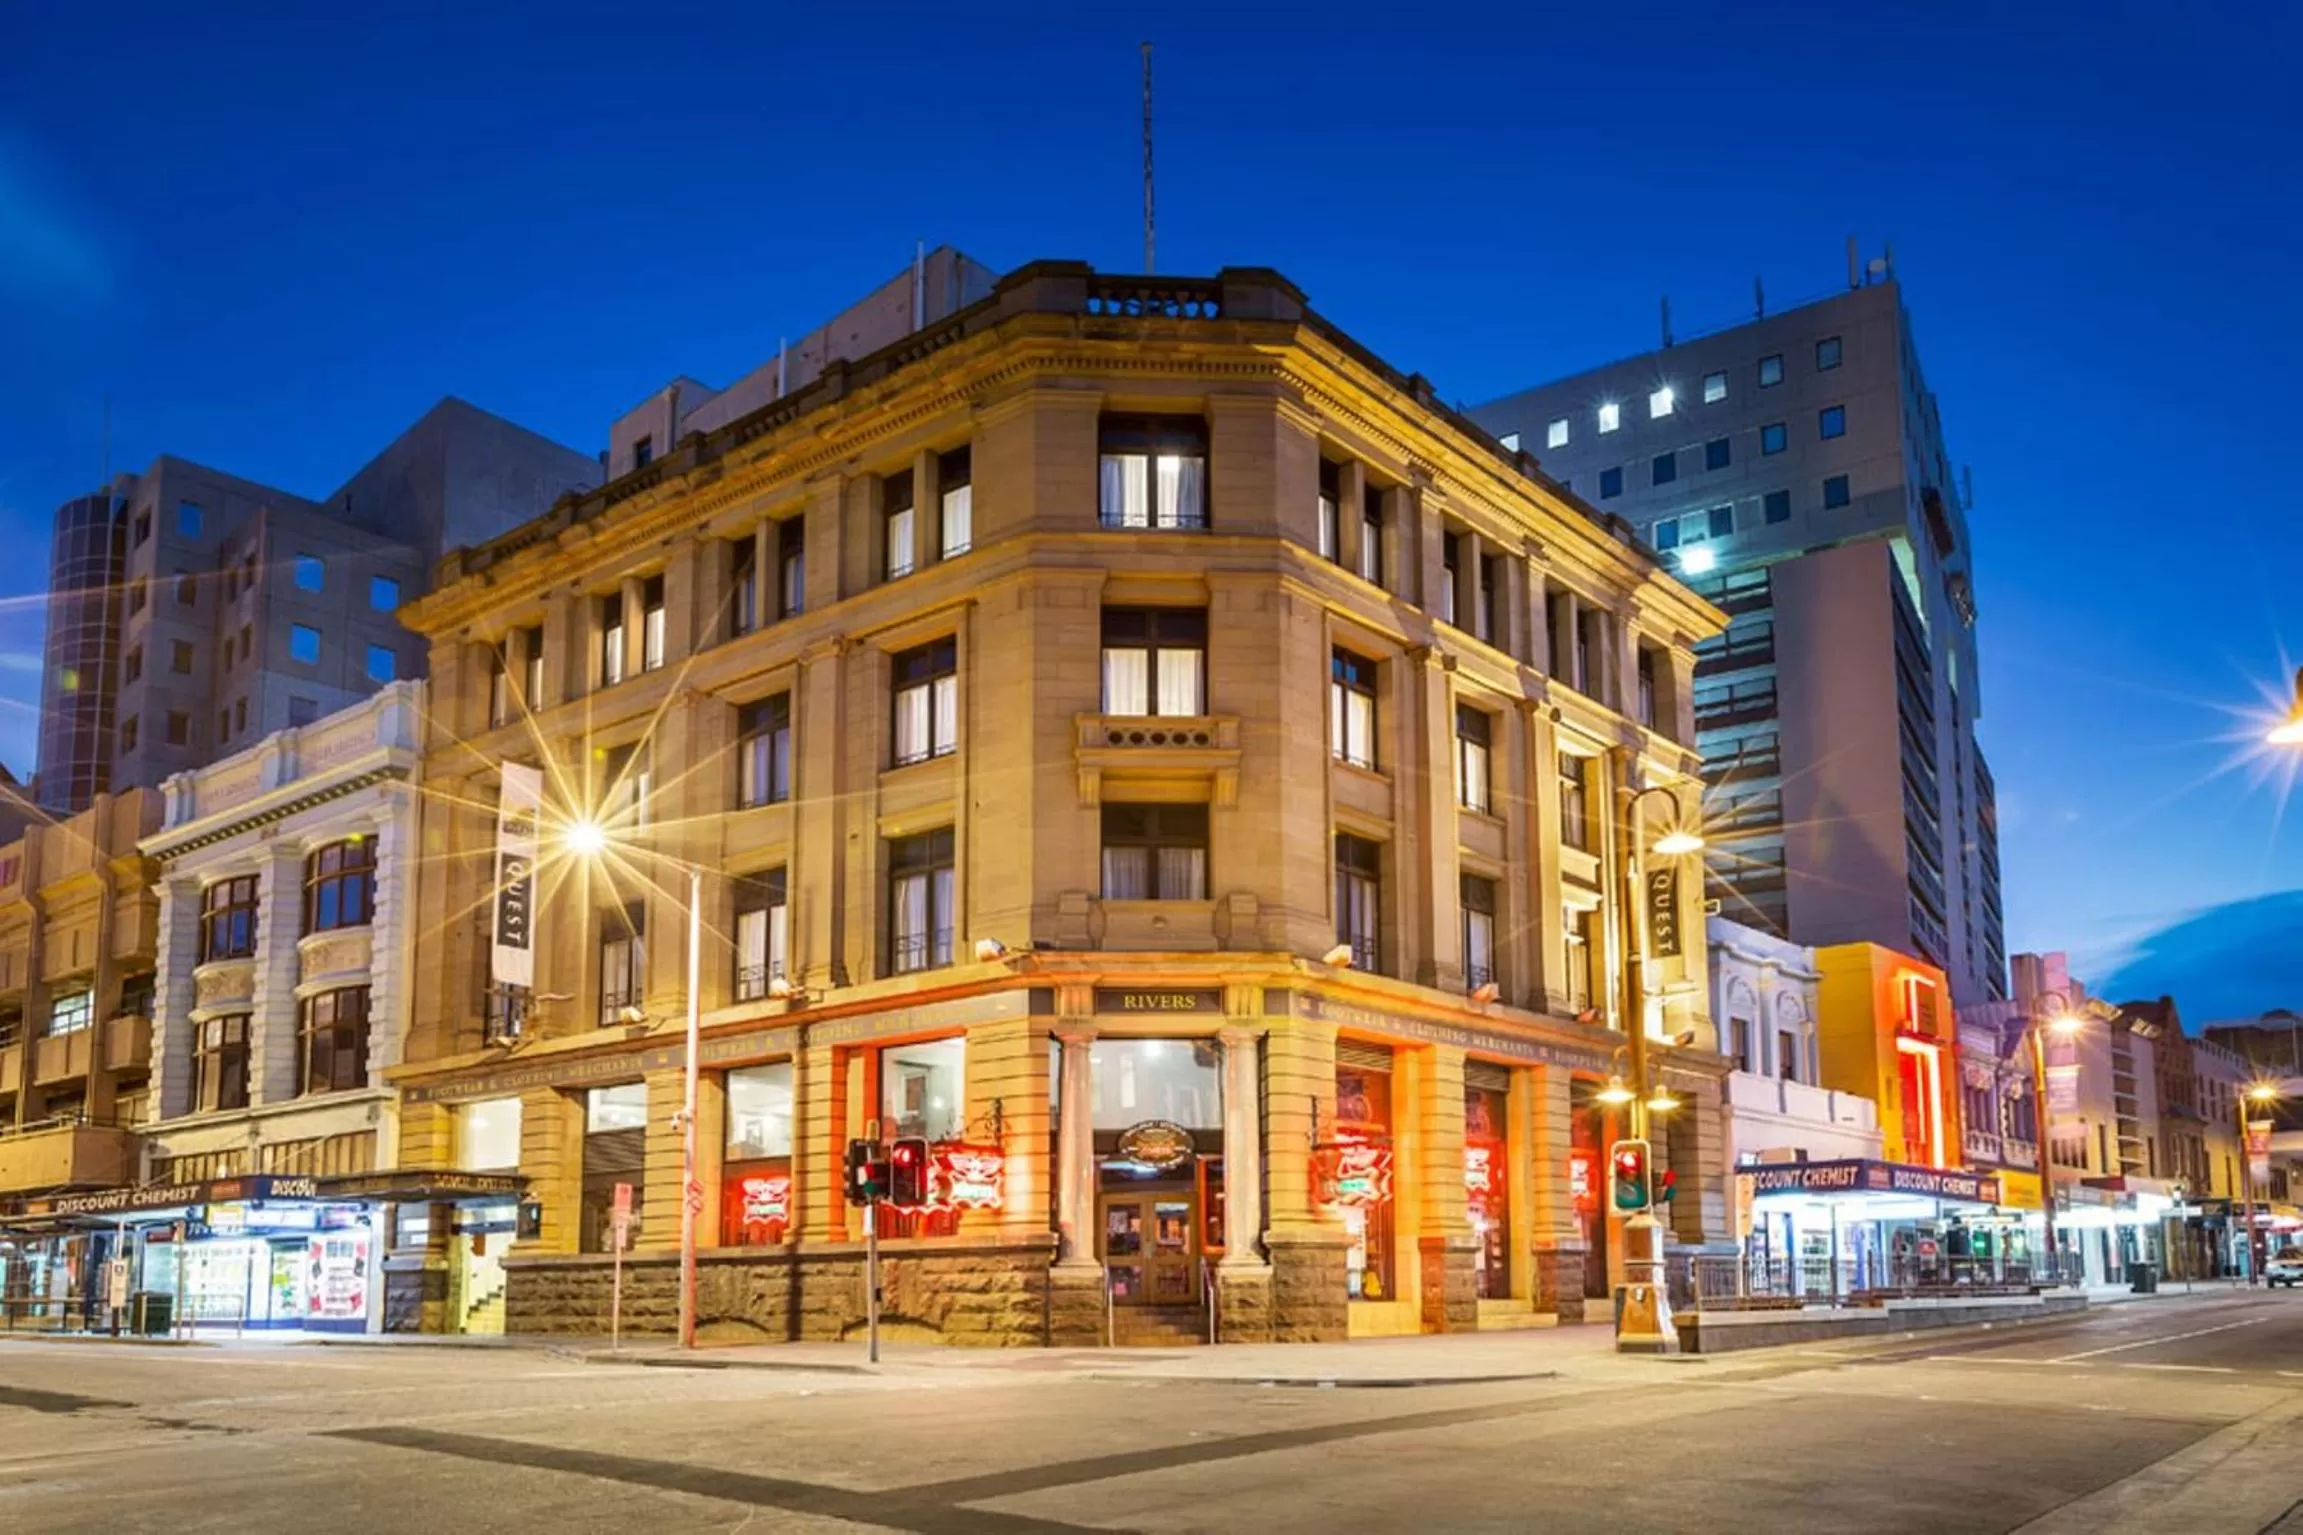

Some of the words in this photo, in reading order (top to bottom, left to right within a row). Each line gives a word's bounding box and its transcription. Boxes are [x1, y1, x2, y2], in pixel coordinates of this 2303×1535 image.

[506, 861, 524, 943] QUEST
[1652, 874, 1673, 950] QUEST
[1123, 995, 1196, 1009] RIVERS
[1802, 1166, 1858, 1188] CHEMIST
[1894, 1170, 1941, 1192] DISCOUNT
[56, 1194, 129, 1214] DISCOUNT
[132, 1186, 201, 1205] CHEMIST
